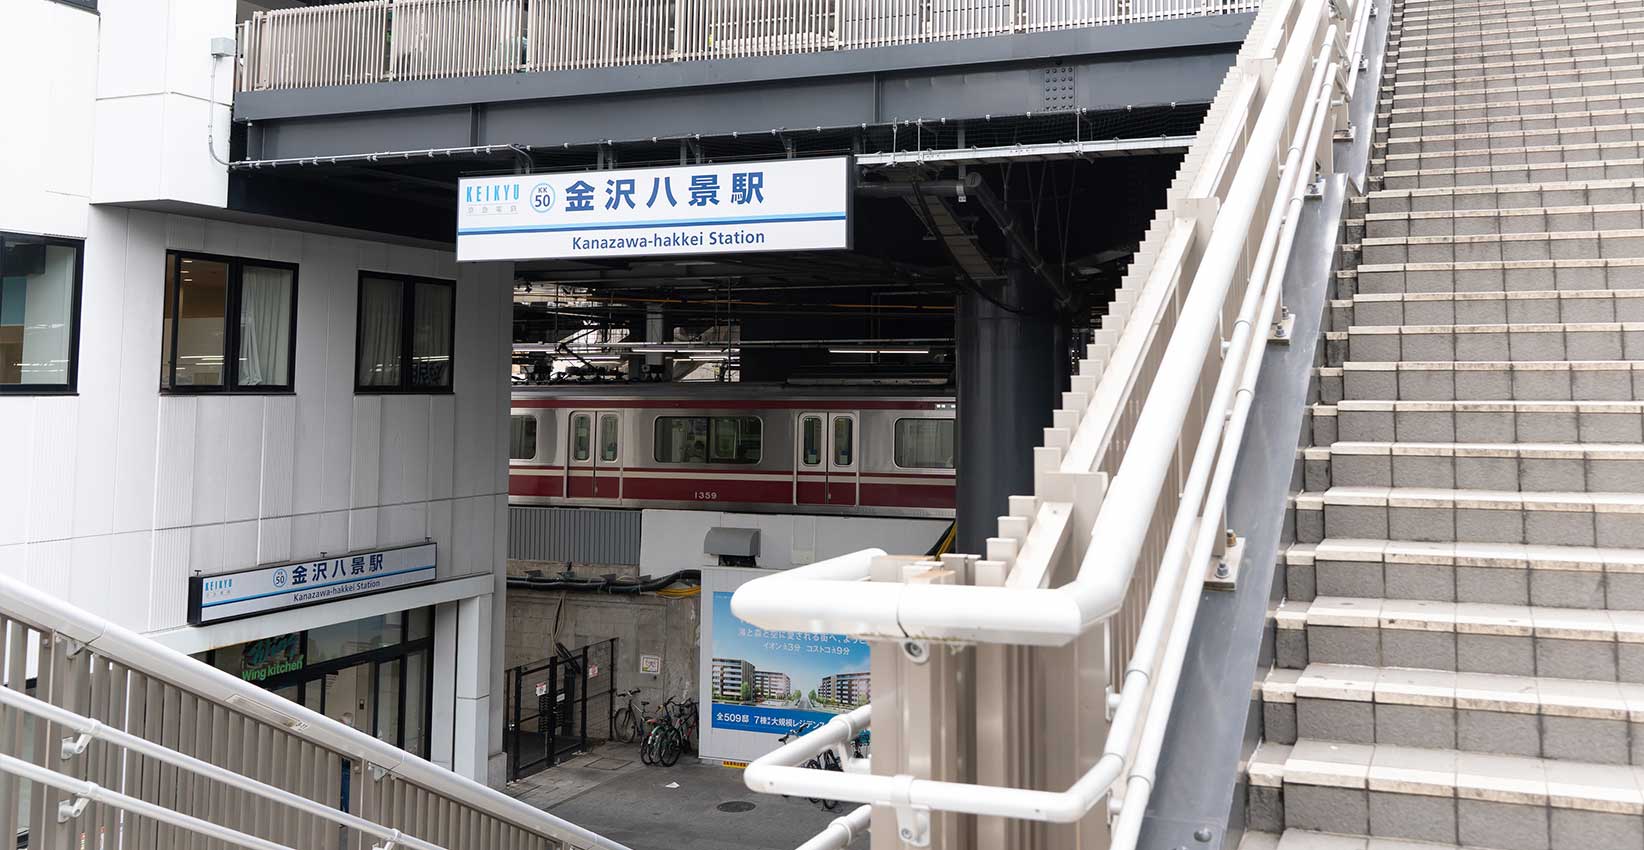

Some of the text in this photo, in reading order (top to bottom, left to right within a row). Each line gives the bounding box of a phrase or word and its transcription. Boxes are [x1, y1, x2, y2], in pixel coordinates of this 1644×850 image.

[466, 184, 520, 203] KEIKYU
[537, 186, 548, 194] KK
[565, 171, 765, 212] 金沢八景駅
[534, 194, 551, 208] 50
[572, 229, 765, 250] Kanazawa-hakkei Station
[694, 491, 717, 499] 1359
[291, 553, 384, 585] 金沢八景駅
[275, 575, 285, 585] 50
[294, 579, 381, 602] Kanazawa-hakkei Station
[242, 656, 303, 681] Wing kitchen
